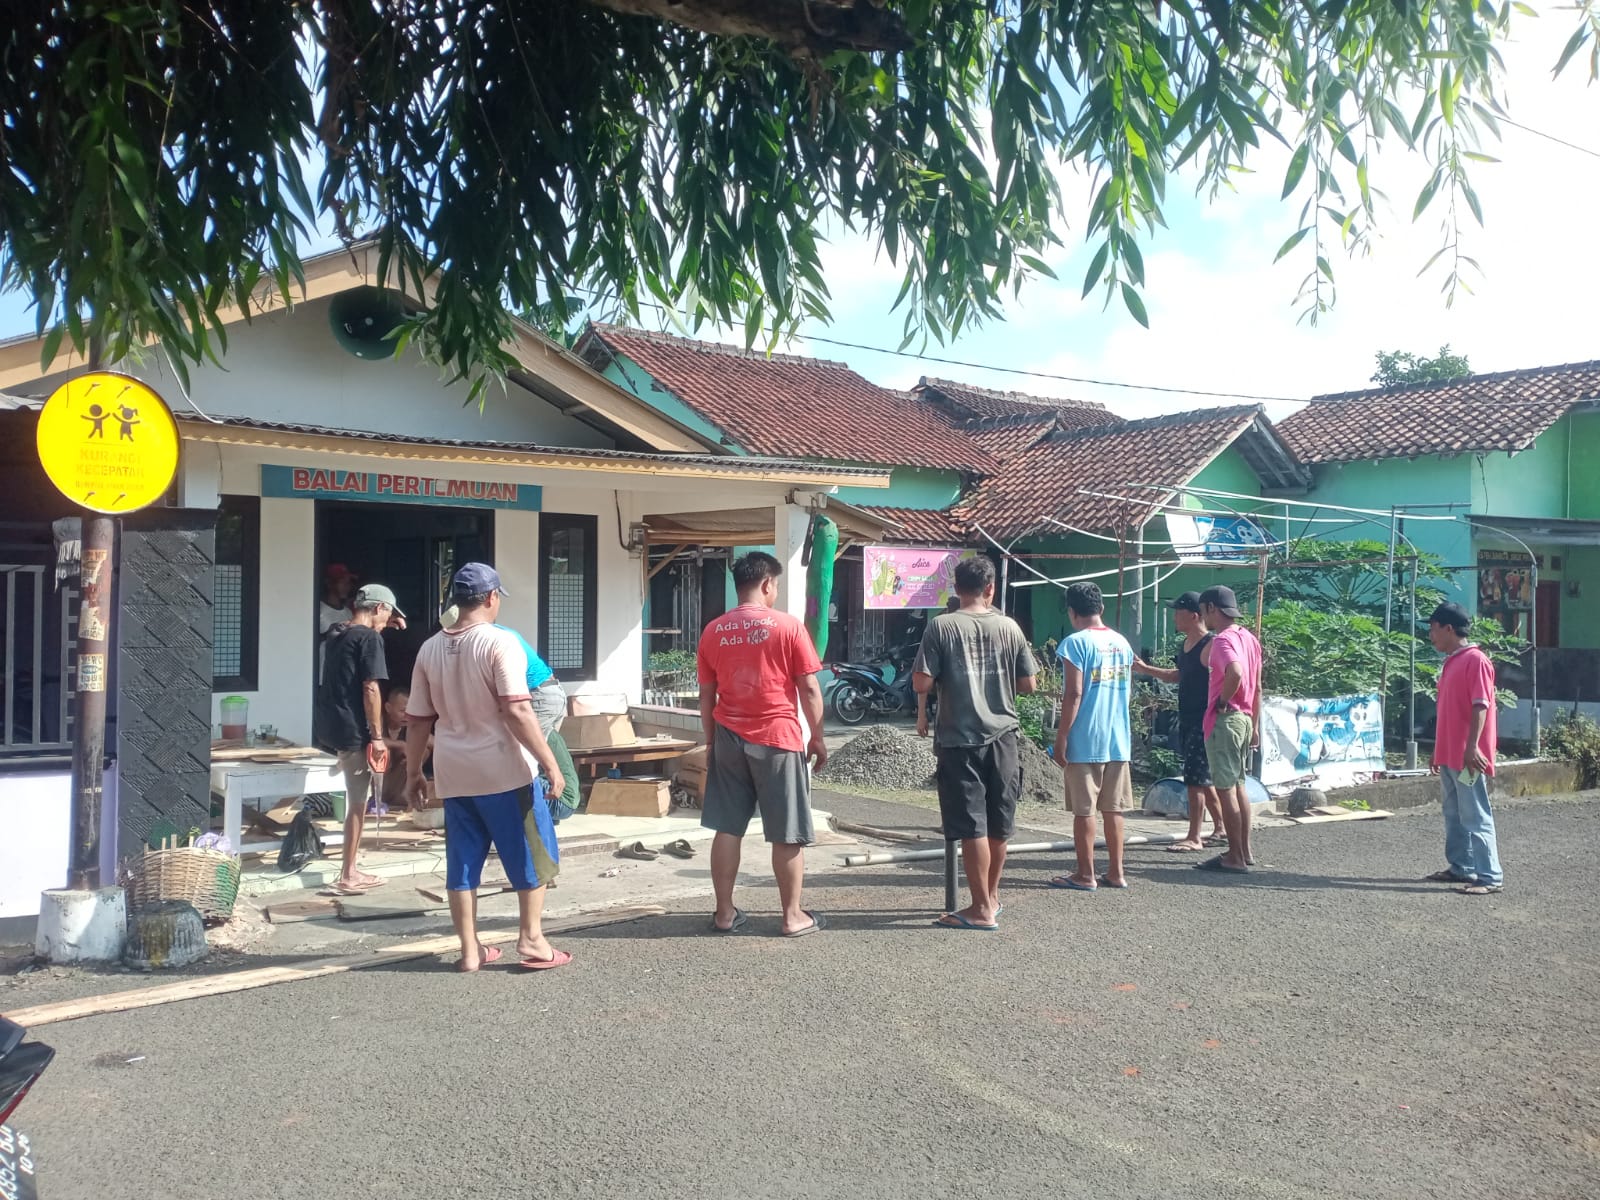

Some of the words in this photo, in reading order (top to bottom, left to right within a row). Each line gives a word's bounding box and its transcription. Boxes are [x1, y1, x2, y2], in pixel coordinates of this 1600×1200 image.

[293, 468, 368, 492] BALAI
[715, 621, 739, 633] Ada
[720, 635, 743, 647] Ada
